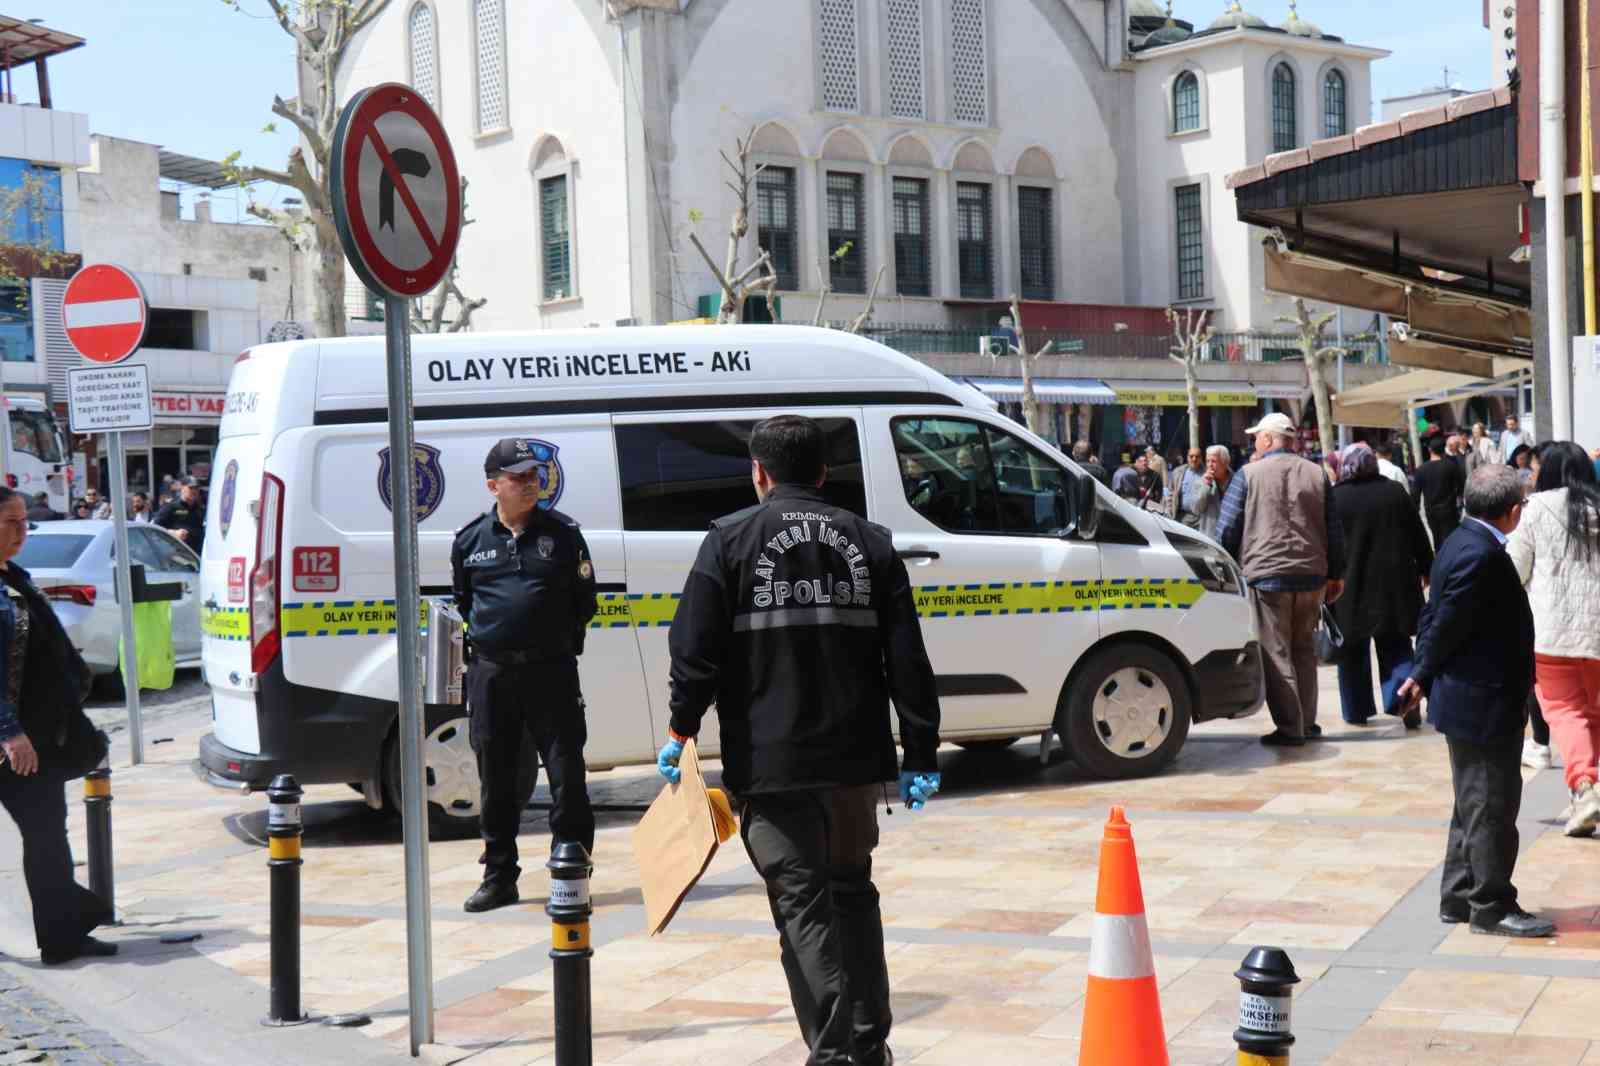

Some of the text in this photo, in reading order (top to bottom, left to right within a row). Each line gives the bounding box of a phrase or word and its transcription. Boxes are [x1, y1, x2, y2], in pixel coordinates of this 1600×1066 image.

[428, 358, 495, 382] OLAY
[299, 551, 334, 573] 112
[1074, 589, 1099, 600] OLAY
[593, 605, 630, 616] ELEME
[323, 612, 354, 623] OLAY
